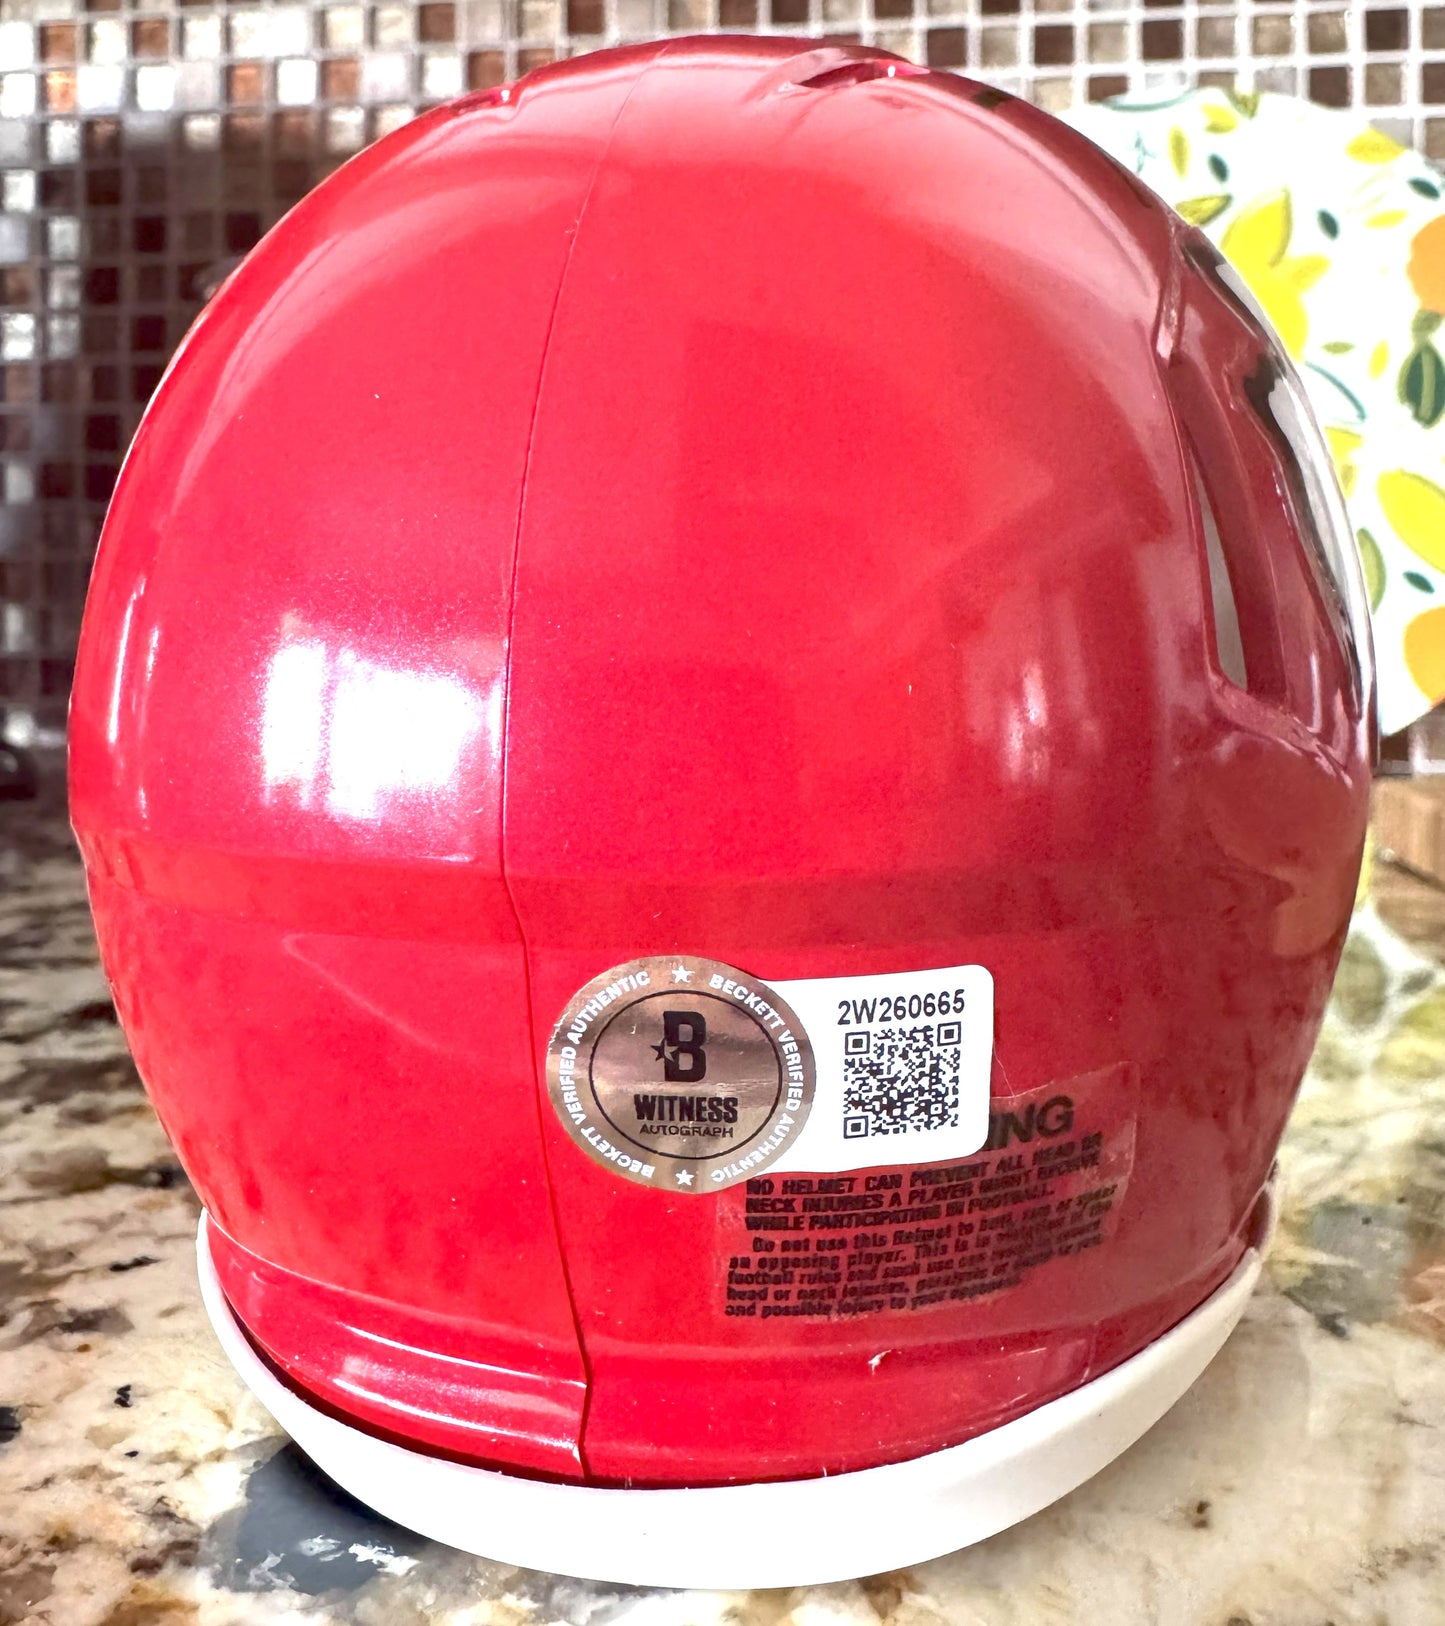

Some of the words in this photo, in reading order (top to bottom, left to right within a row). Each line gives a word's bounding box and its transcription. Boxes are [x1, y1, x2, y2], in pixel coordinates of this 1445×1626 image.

[567, 971, 650, 1045] AUTHENTIC
[709, 974, 785, 1029] BECKETT
[837, 989, 965, 1025] 2W260665
[663, 1010, 707, 1082] B
[560, 1046, 586, 1126] VERIFIED
[778, 1029, 804, 1111] VERIFIED
[634, 1094, 738, 1124] WITNESS
[639, 1123, 733, 1138] AUTOGRAPH
[711, 1113, 795, 1182] AUTHENTIC
[581, 1126, 656, 1178] BECKETT
[746, 1179, 774, 1195] NO
[782, 1177, 858, 1195] HELMET
[864, 1174, 902, 1191] CAN
[910, 1161, 990, 1186] PREVENT
[995, 1155, 1025, 1173] ALL
[746, 1198, 796, 1213] NECK
[802, 1194, 884, 1212] INJURIES
[889, 1192, 902, 1207] A
[908, 1181, 973, 1205] PLAYER
[745, 1216, 804, 1231] WHILE
[809, 1204, 942, 1231] PARTICIPATING
[753, 1237, 775, 1252] Do
[781, 1238, 810, 1252] not
[816, 1238, 847, 1251] use
[853, 1233, 887, 1249] this
[958, 1222, 974, 1236] to
[758, 1254, 840, 1271] opposing
[914, 1243, 948, 1260] This
[728, 1271, 794, 1285] football
[725, 1302, 756, 1316] and
